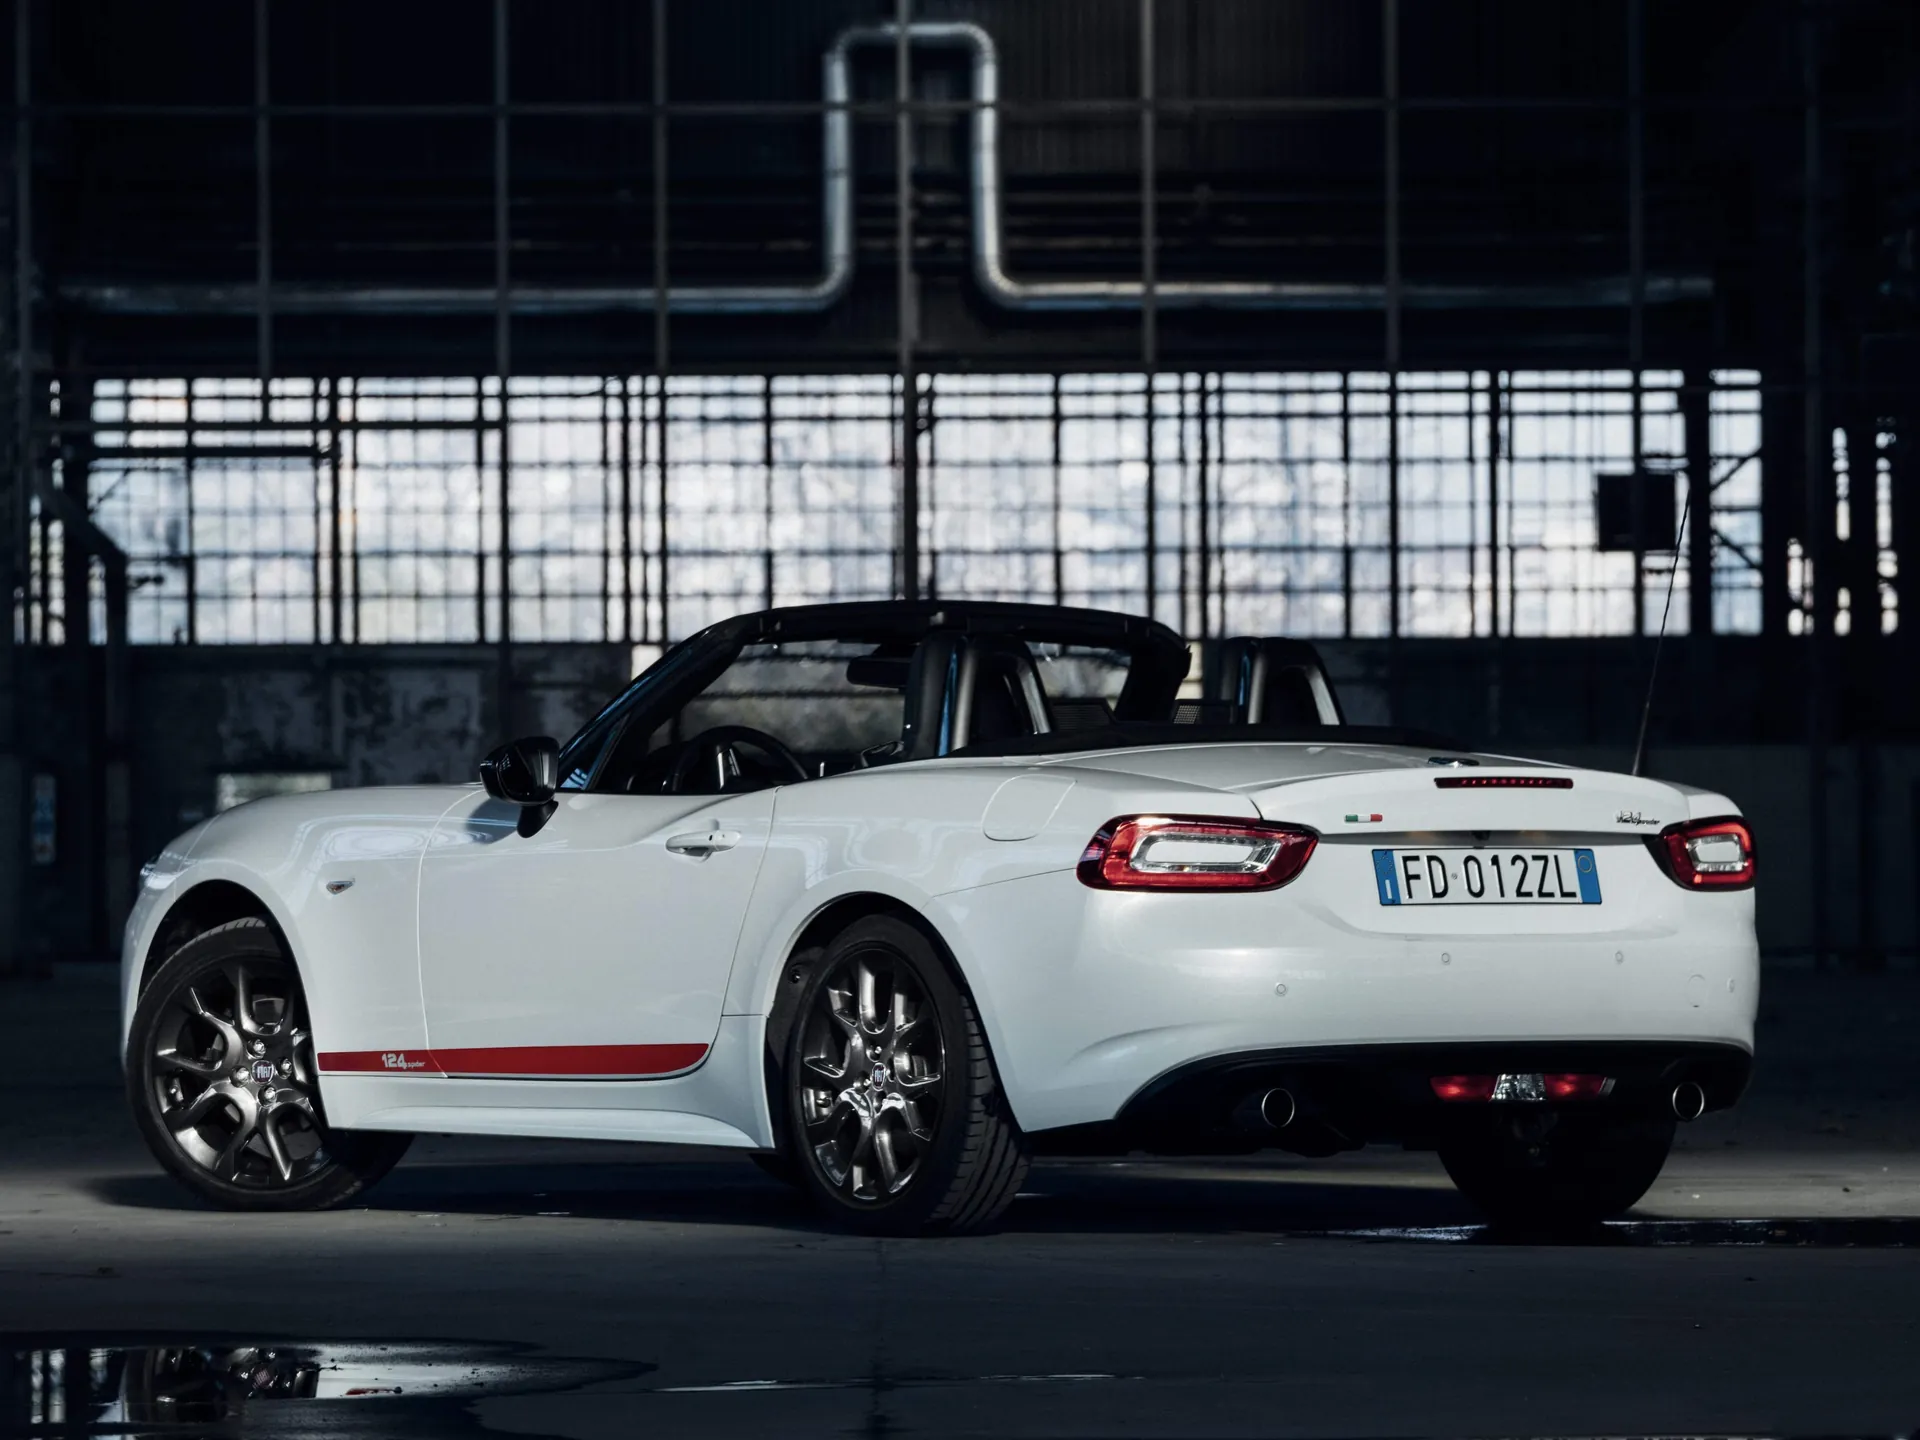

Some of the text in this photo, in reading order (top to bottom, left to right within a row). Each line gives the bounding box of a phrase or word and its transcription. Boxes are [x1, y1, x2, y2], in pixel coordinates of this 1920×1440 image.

[1401, 854, 1577, 899] FD 012ZL
[381, 1053, 407, 1069] 124
[257, 1065, 272, 1078] FIAT
